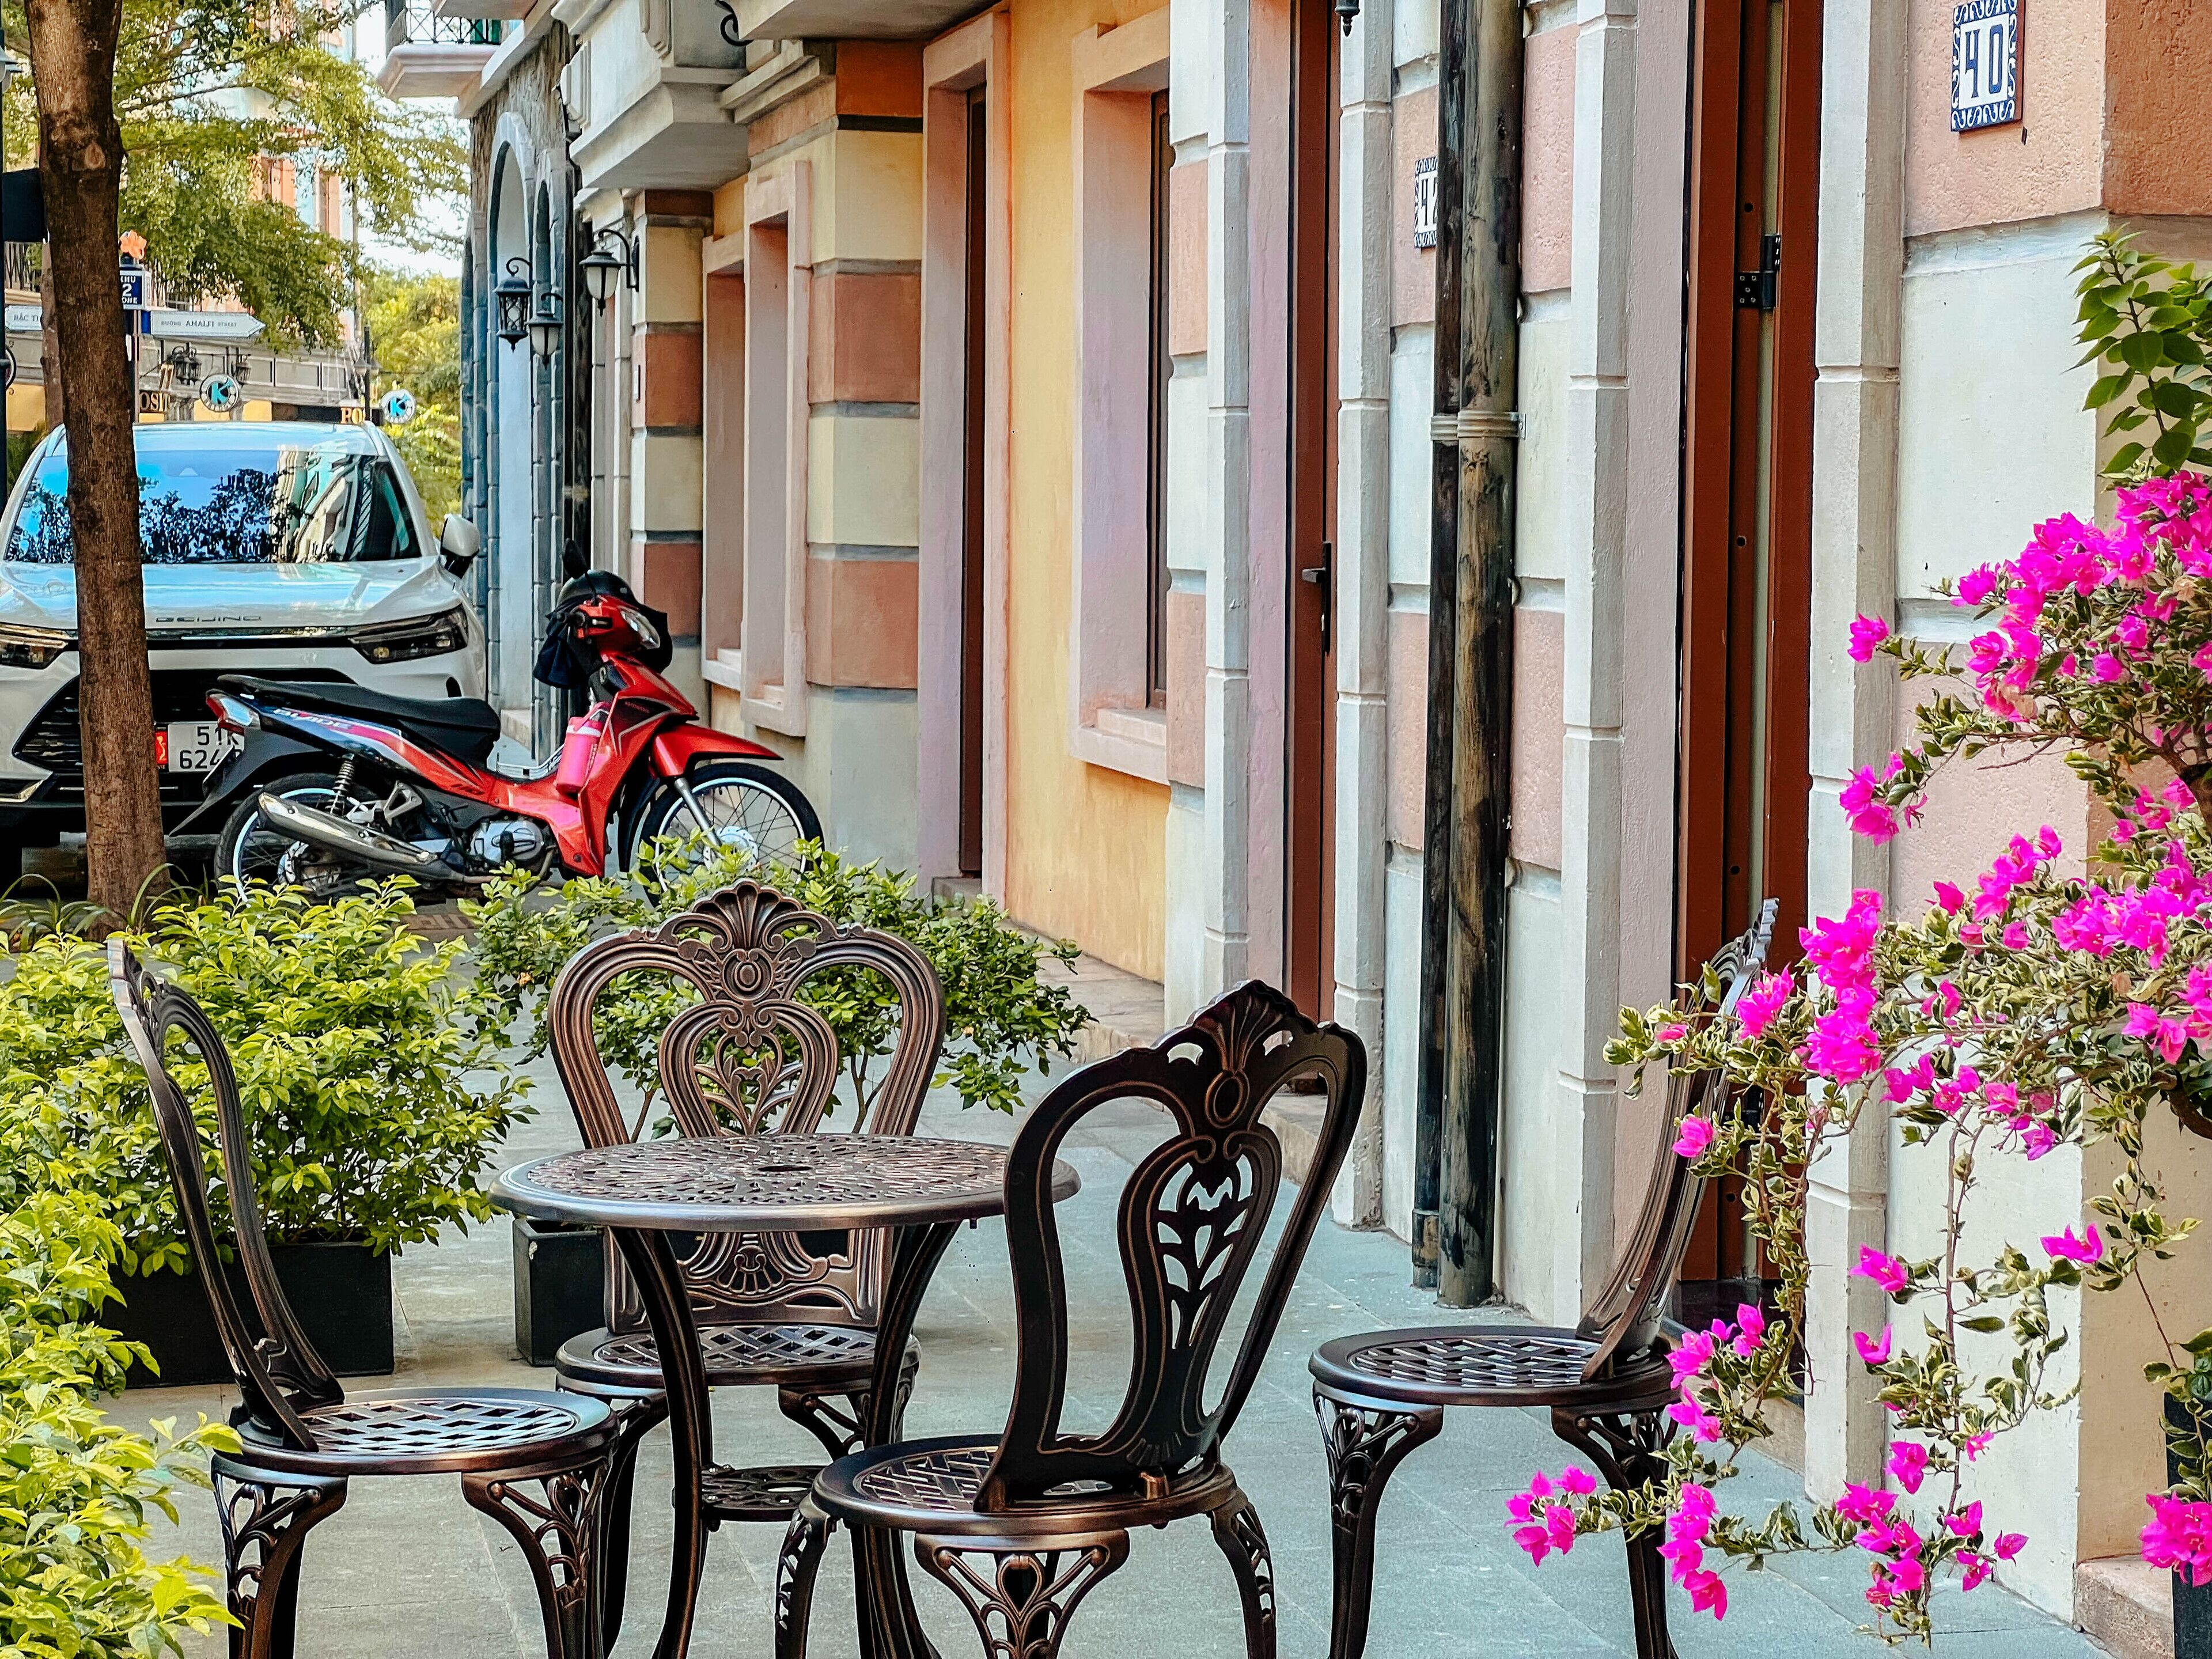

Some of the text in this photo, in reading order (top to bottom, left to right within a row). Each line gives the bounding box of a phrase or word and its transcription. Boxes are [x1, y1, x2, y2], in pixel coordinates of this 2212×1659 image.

[1965, 24, 2003, 98] 40
[122, 283, 132, 297] 2
[139, 392, 171, 412] OSIT
[340, 407, 366, 425] PO
